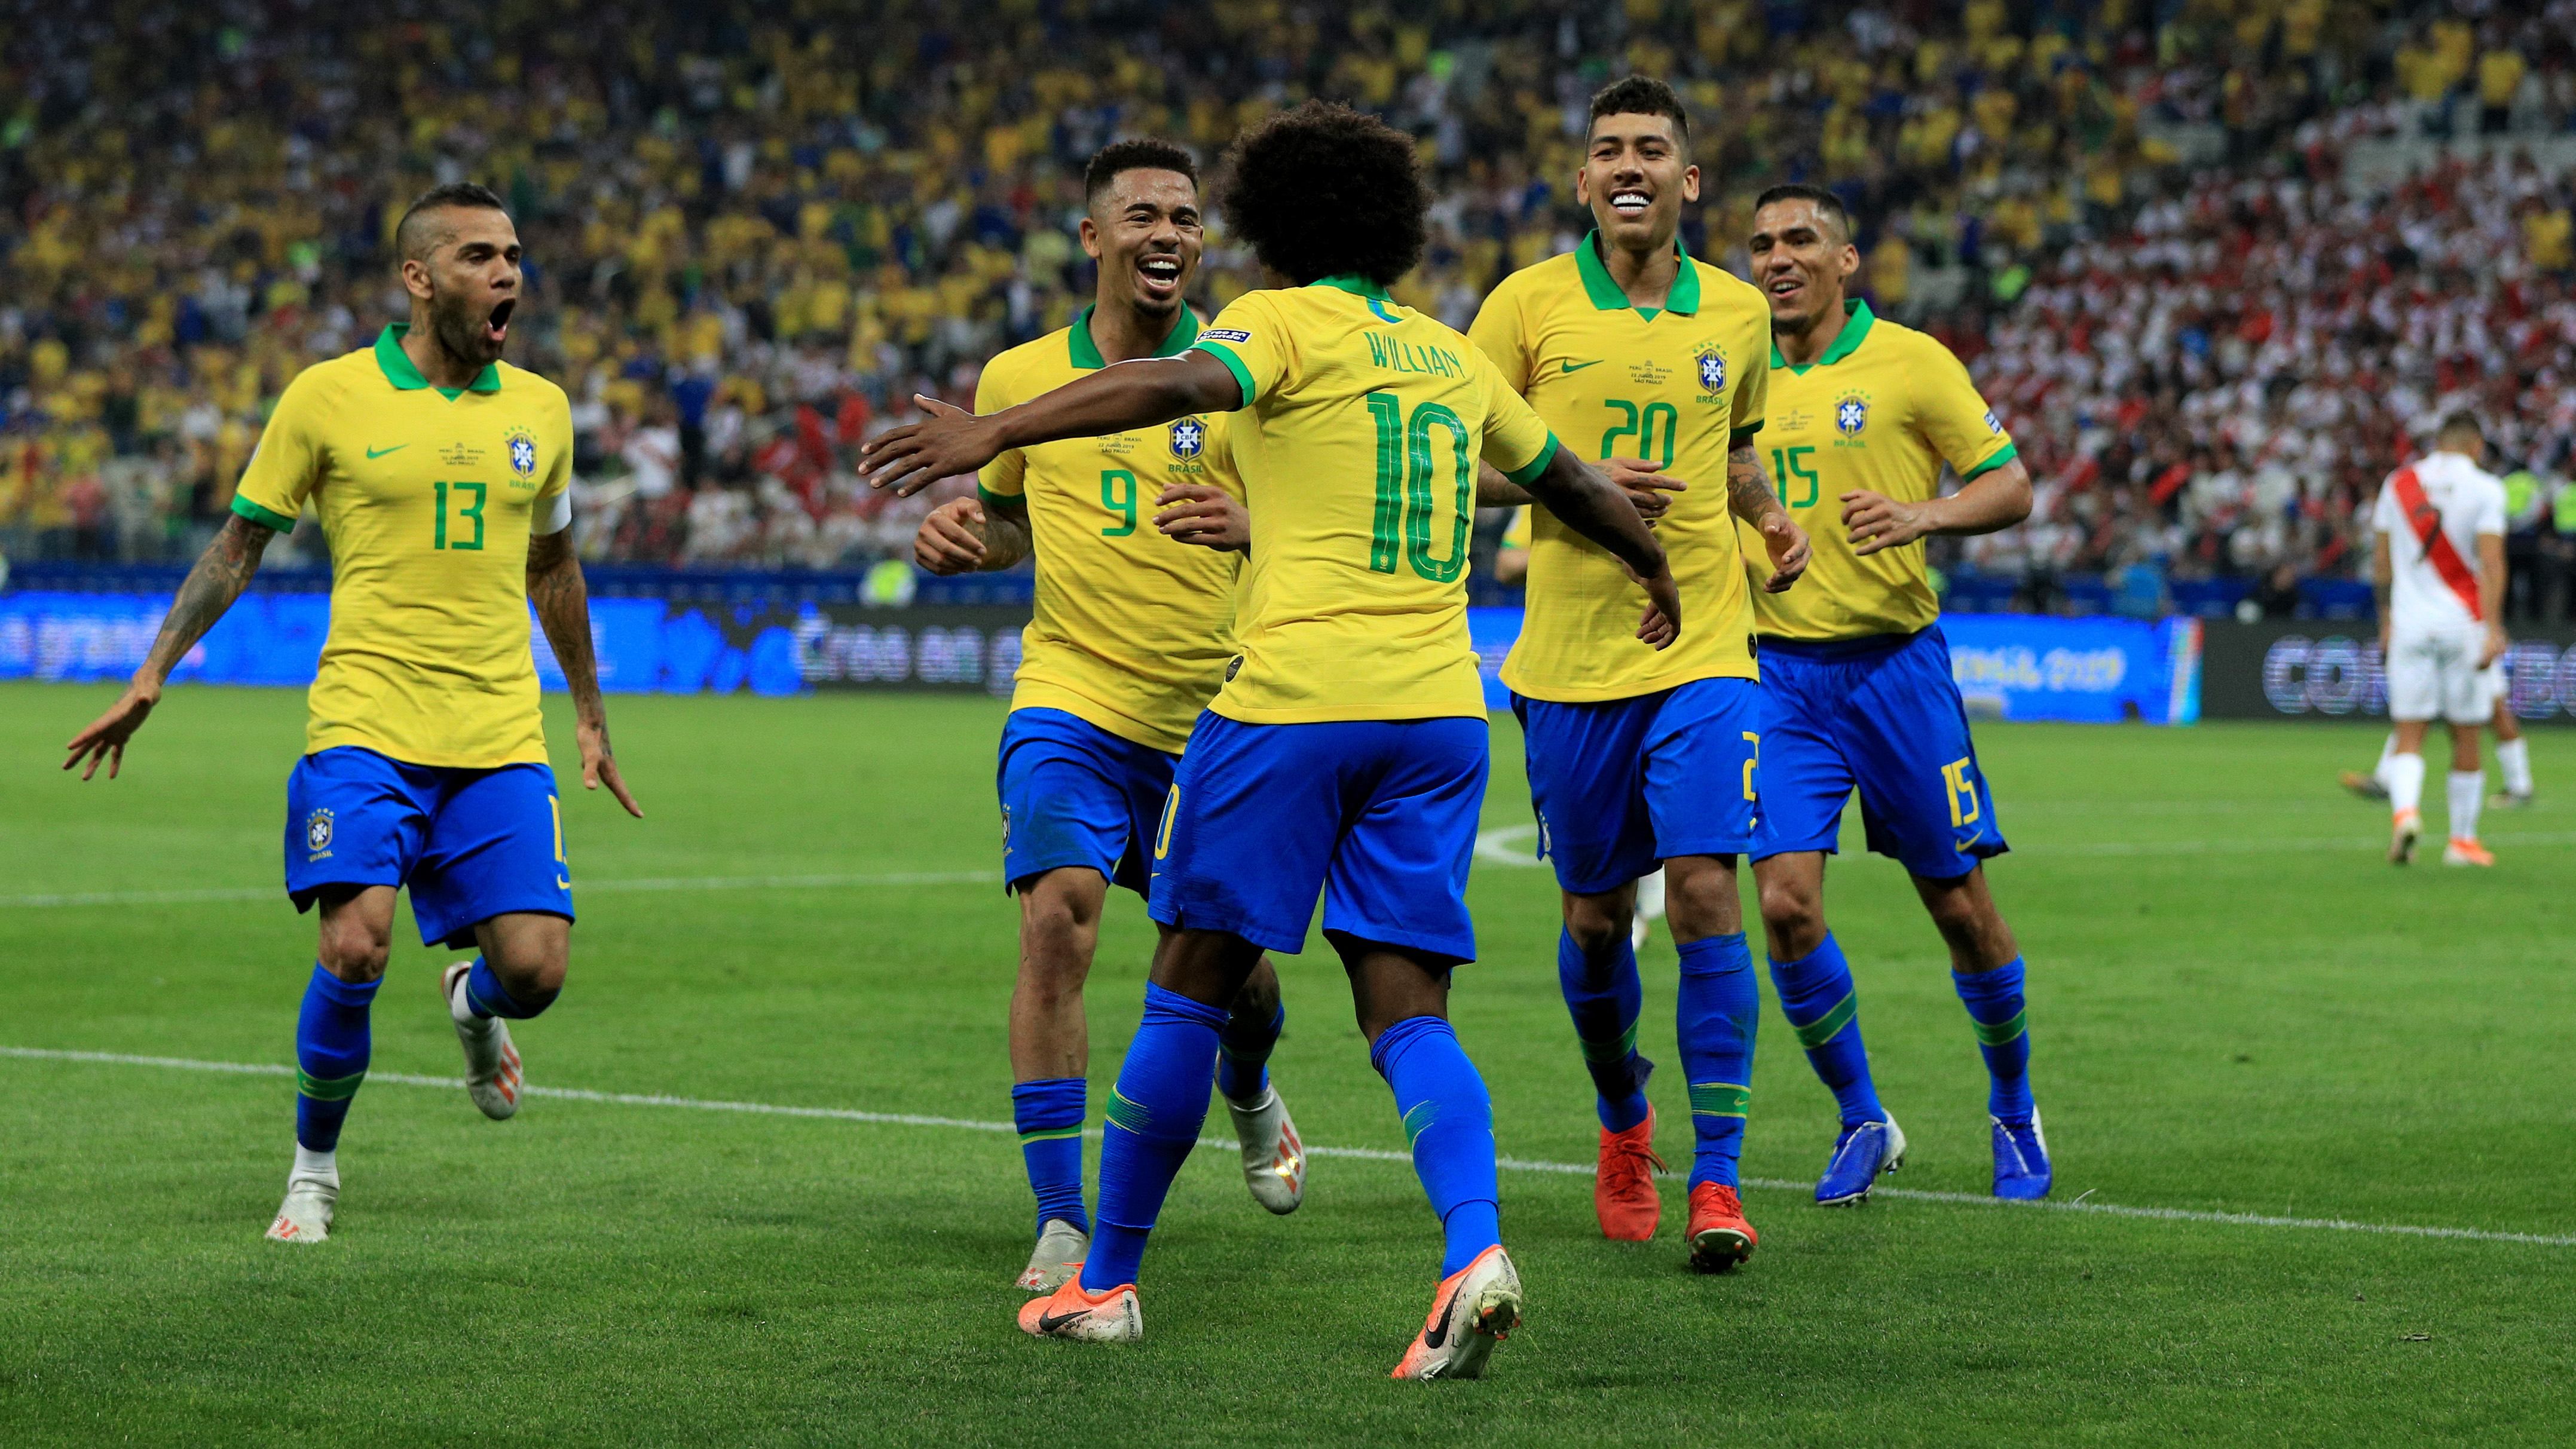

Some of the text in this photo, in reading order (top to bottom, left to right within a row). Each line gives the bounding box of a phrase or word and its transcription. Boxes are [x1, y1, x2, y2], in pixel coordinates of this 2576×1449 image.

[1363, 332, 1466, 378] WILLIAN
[1696, 396, 1723, 406] BRASIL
[1601, 399, 1678, 471] 20
[509, 479, 536, 491] BRASIL
[1168, 464, 1203, 473] BRASIL
[1367, 392, 1470, 583] 10
[1772, 446, 1818, 508] 15
[434, 481, 487, 550] 13
[1101, 469, 1136, 537] 9
[1742, 731, 1760, 801] 2
[1941, 756, 1980, 828] 15
[310, 850, 334, 862] BRASIL
